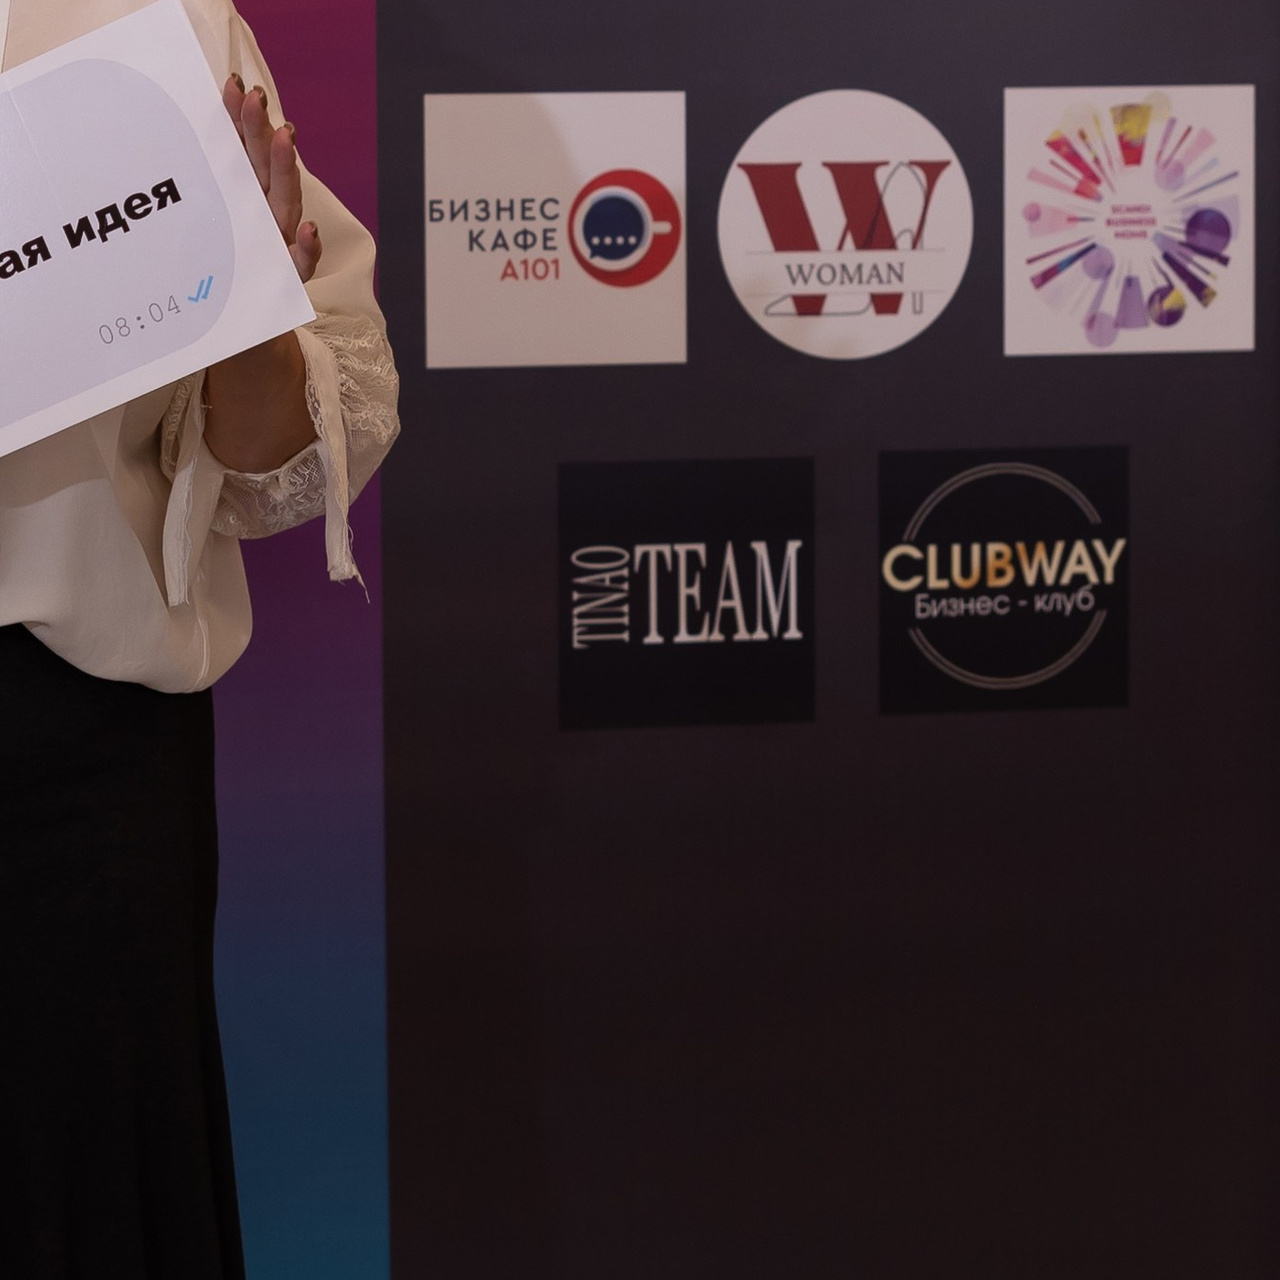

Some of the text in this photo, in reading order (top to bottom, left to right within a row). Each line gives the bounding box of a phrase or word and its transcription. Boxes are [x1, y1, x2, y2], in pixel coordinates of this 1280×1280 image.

[62, 177, 182, 249] идея
[428, 197, 561, 223] БИЗНЕС
[468, 227, 559, 252] КАФЕ
[785, 262, 905, 286] WOMAN
[98, 294, 182, 345] 08:04
[882, 538, 1127, 592] CLUBWAY
[571, 545, 631, 650] TINAO
[634, 539, 803, 645] TEAM
[914, 592, 1012, 619] Бизнес
[1034, 584, 1095, 616] клуб
